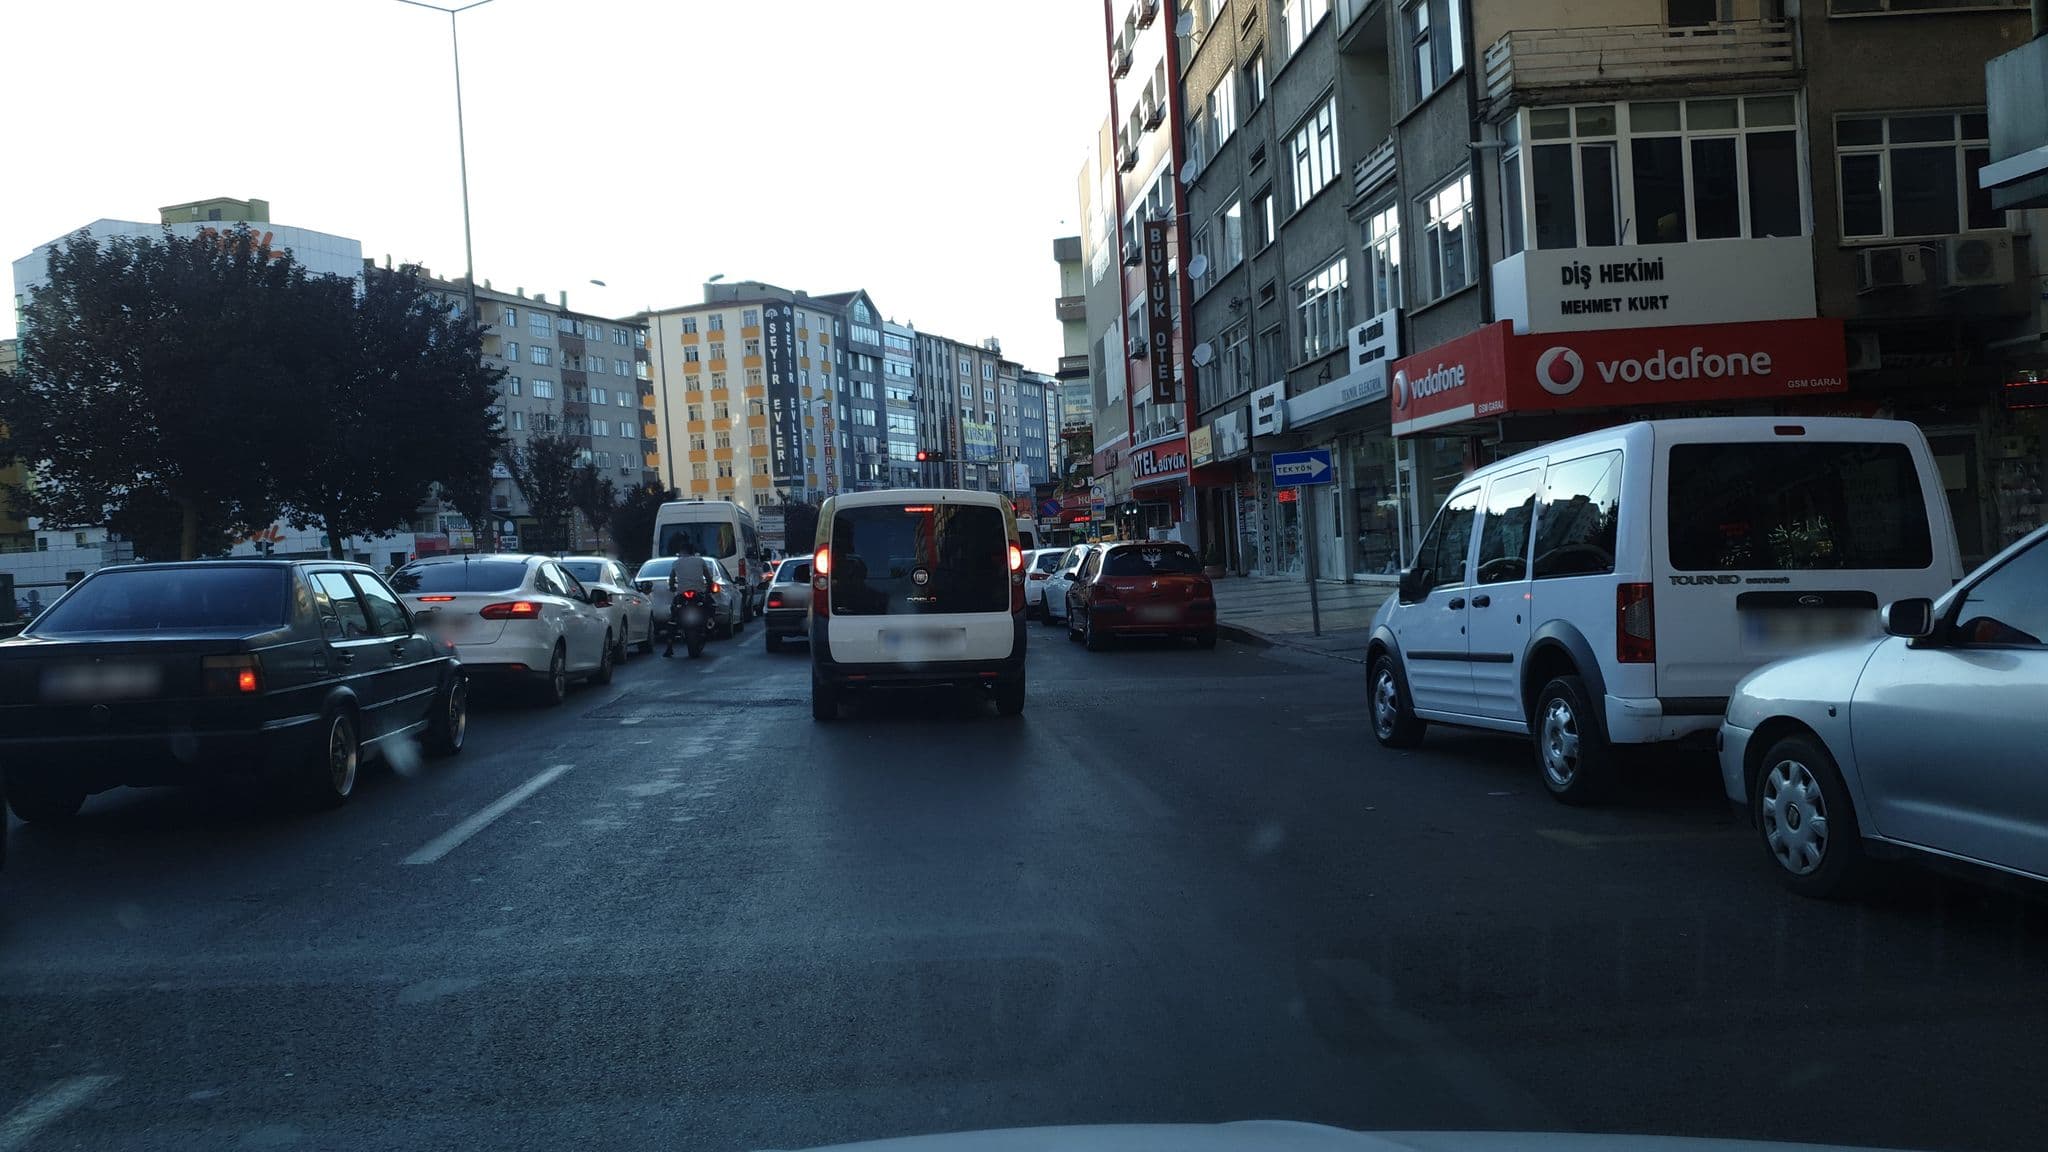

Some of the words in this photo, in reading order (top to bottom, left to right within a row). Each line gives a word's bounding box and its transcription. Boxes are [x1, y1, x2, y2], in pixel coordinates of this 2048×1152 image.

[1151, 228, 1166, 318] BÜYÜK
[1561, 261, 1592, 289] DİŞ
[1600, 257, 1664, 283] HEKİMİ
[1561, 298, 1622, 315] MEHMET
[1628, 295, 1669, 311] KURT
[769, 322, 780, 385] SEYİR
[1156, 332, 1169, 397] OTEL
[1596, 347, 1772, 384] vodafone
[1411, 363, 1466, 400] vodafone
[1788, 380, 1808, 389] GSM
[1810, 378, 1842, 387] GARAJ
[774, 399, 785, 473] EVLERİ
[1158, 452, 1186, 472] BÜYÜK
[1295, 464, 1313, 472] YÖN
[1669, 575, 1741, 585] TOURNEO
